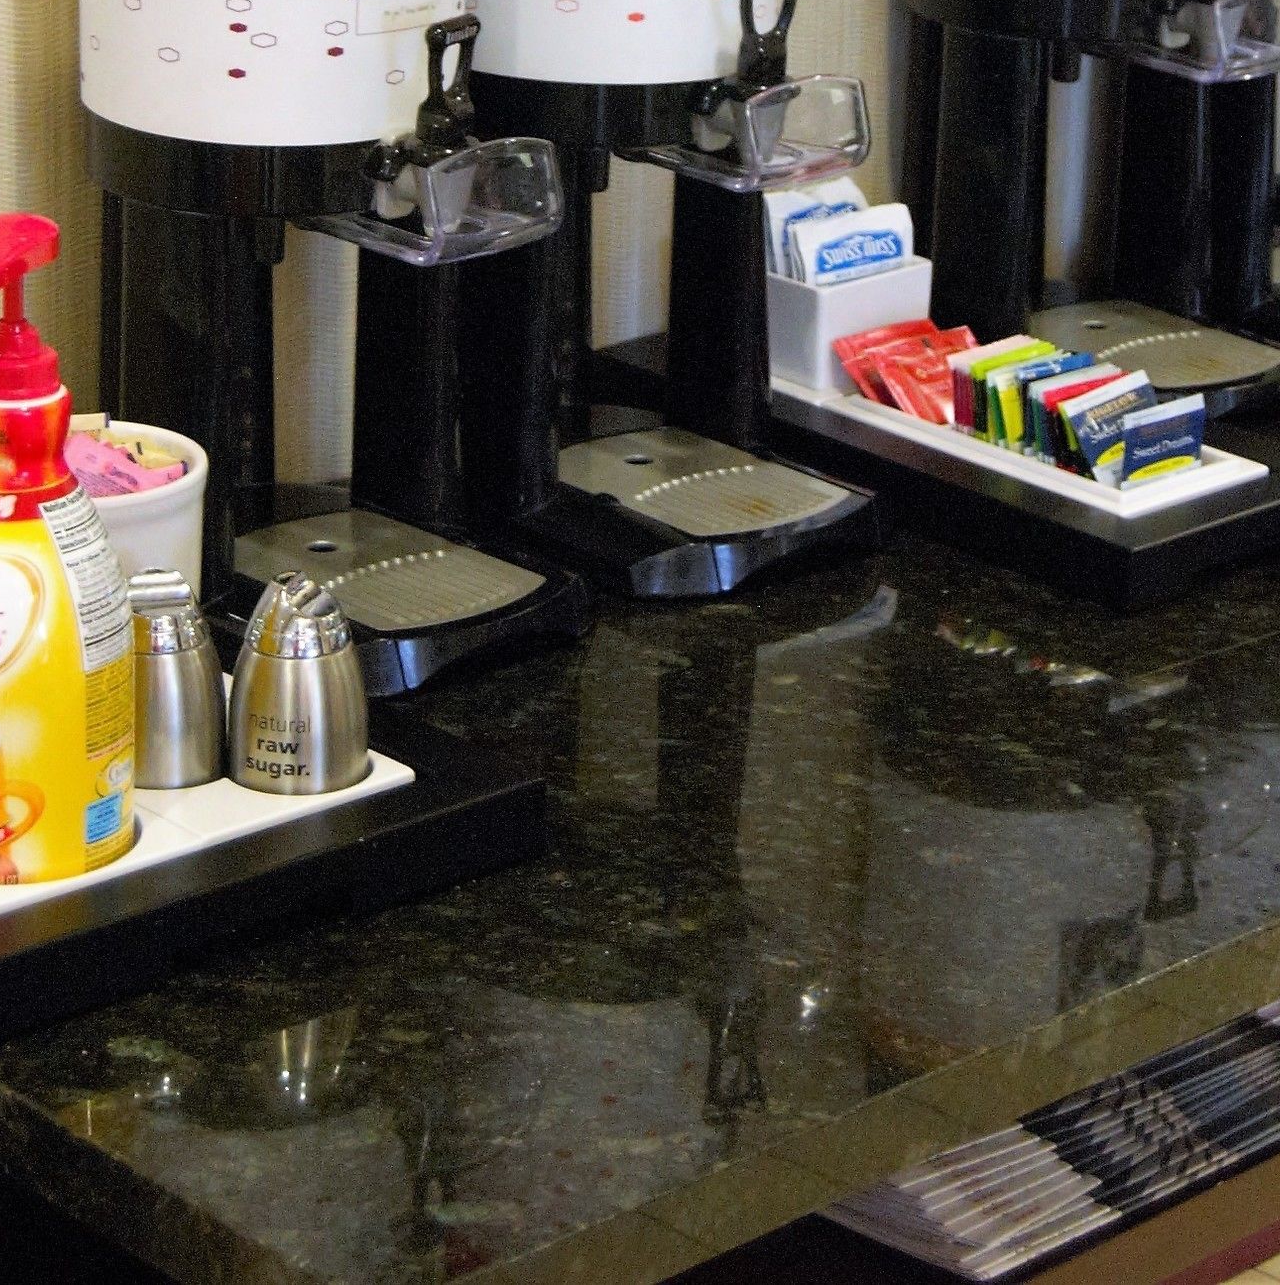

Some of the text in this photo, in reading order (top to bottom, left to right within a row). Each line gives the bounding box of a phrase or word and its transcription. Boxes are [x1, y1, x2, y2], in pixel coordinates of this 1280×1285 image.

[249, 715, 311, 733] natural
[256, 738, 299, 755] raw
[246, 756, 311, 779] sugar.
